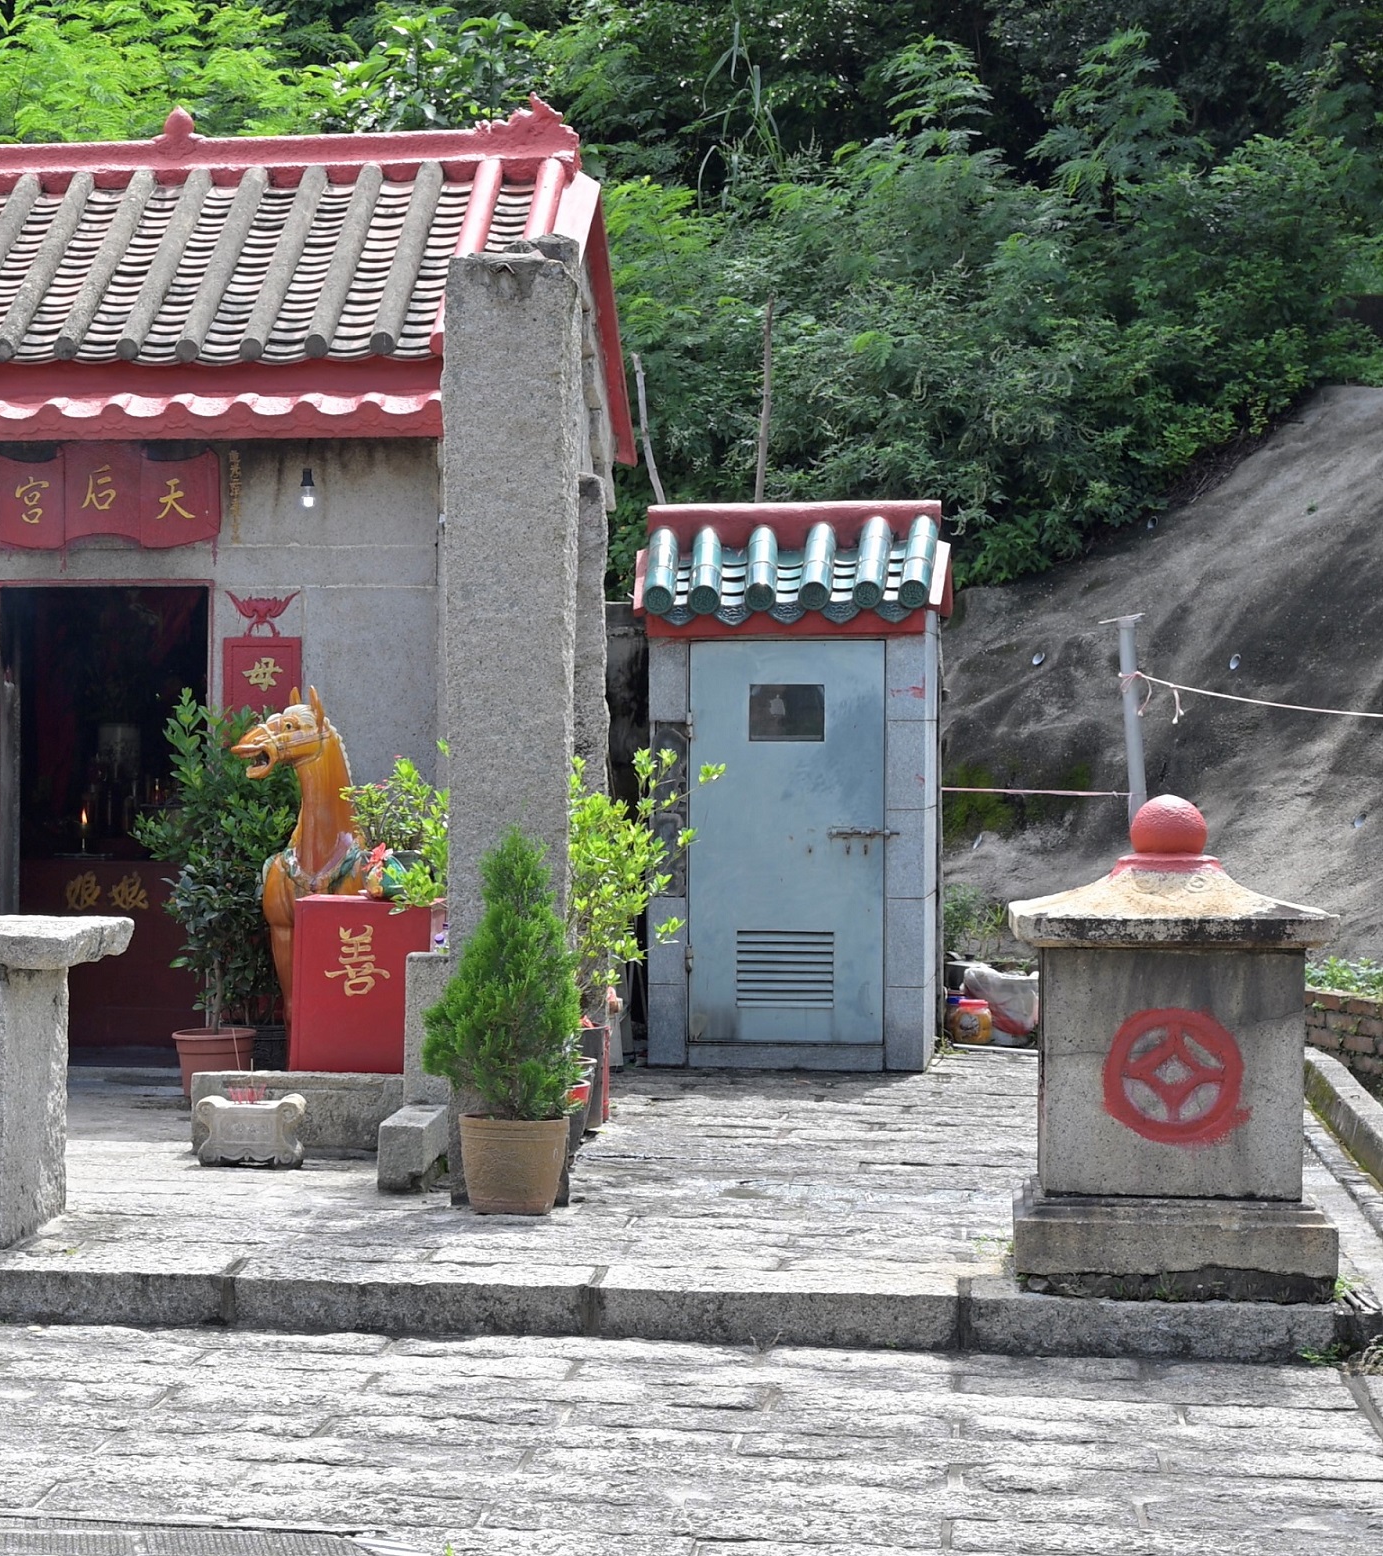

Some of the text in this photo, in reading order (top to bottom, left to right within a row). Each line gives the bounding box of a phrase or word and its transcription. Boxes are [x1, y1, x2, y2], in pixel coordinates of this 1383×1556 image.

[14, 464, 196, 525] 天后宮
[241, 657, 284, 692] 母
[324, 924, 390, 997] 善
